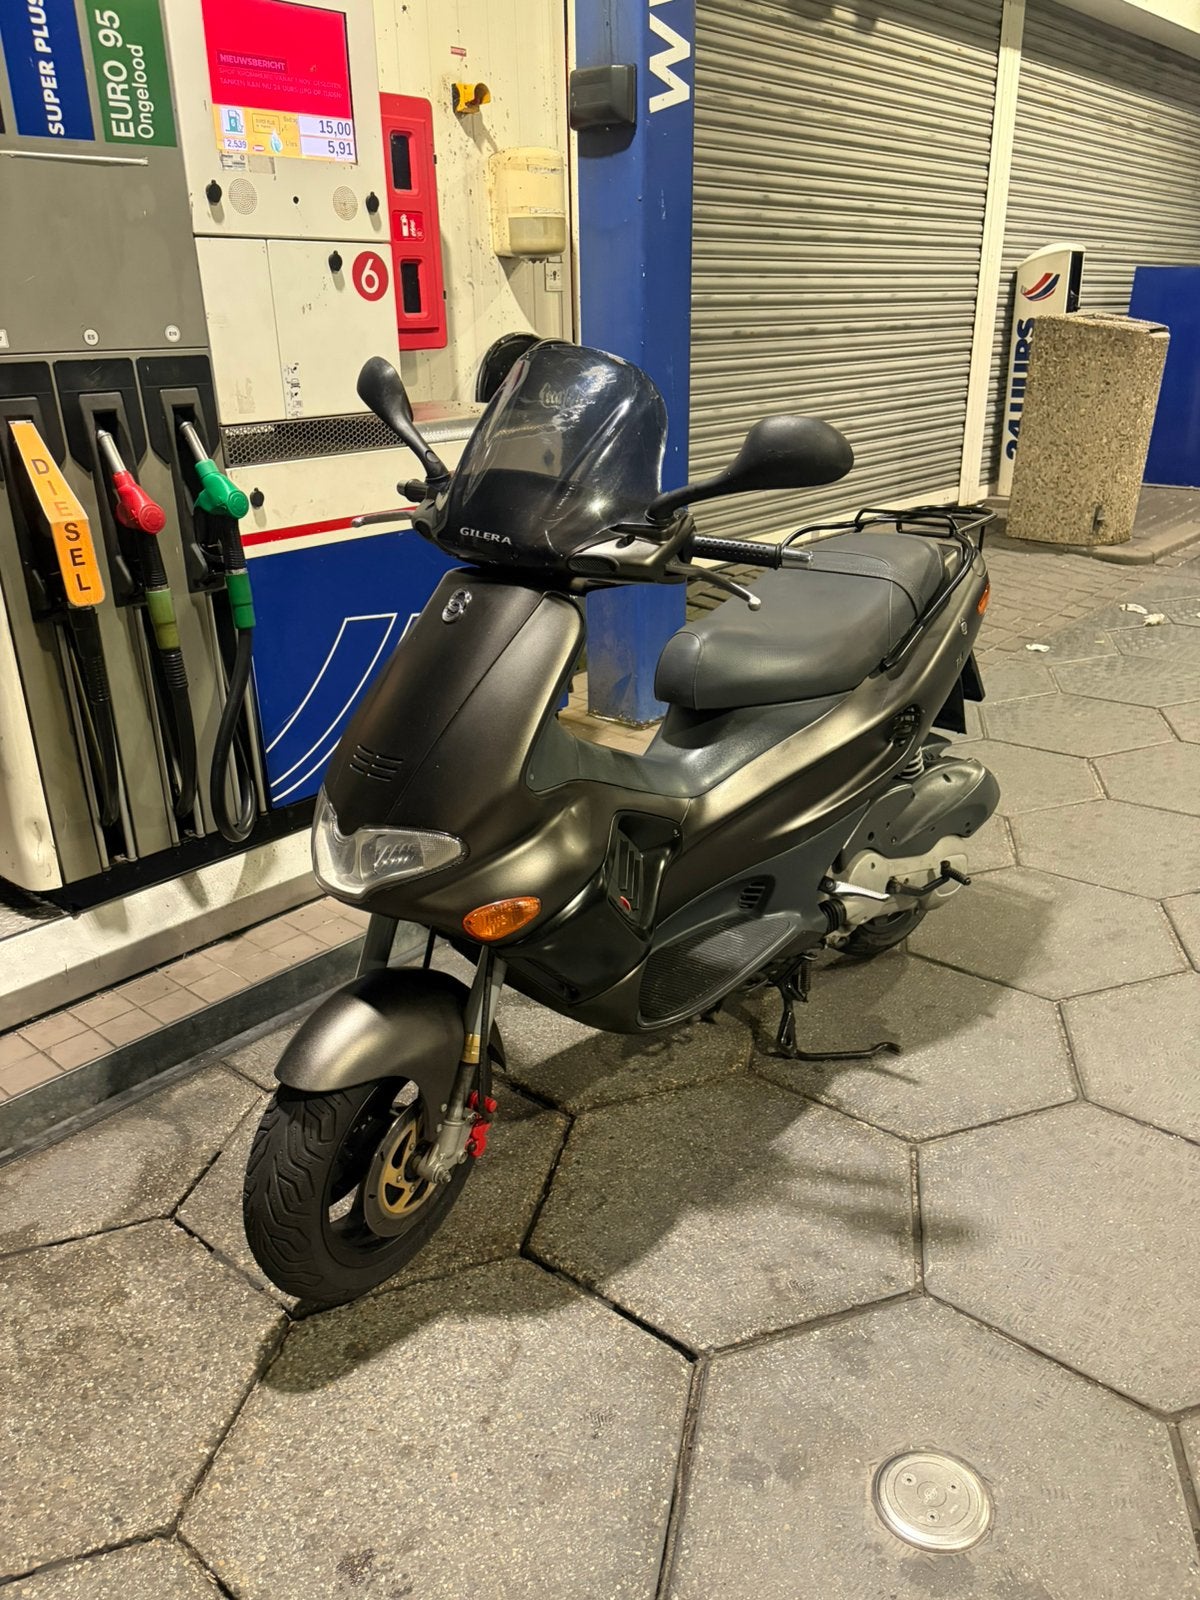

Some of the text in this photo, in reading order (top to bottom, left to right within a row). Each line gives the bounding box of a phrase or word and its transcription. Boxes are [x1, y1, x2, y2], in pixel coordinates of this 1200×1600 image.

[95, 9, 135, 138] EURO 95
[219, 53, 285, 70] NIEUWSBERICHT
[39, 60, 65, 136] SUPER
[126, 44, 154, 139] Ongelood
[319, 119, 351, 137] 15,00
[327, 140, 353, 156] 5,91
[361, 258, 380, 294] 6
[31, 458, 92, 592] DIESEL
[460, 527, 512, 545] GILERA
